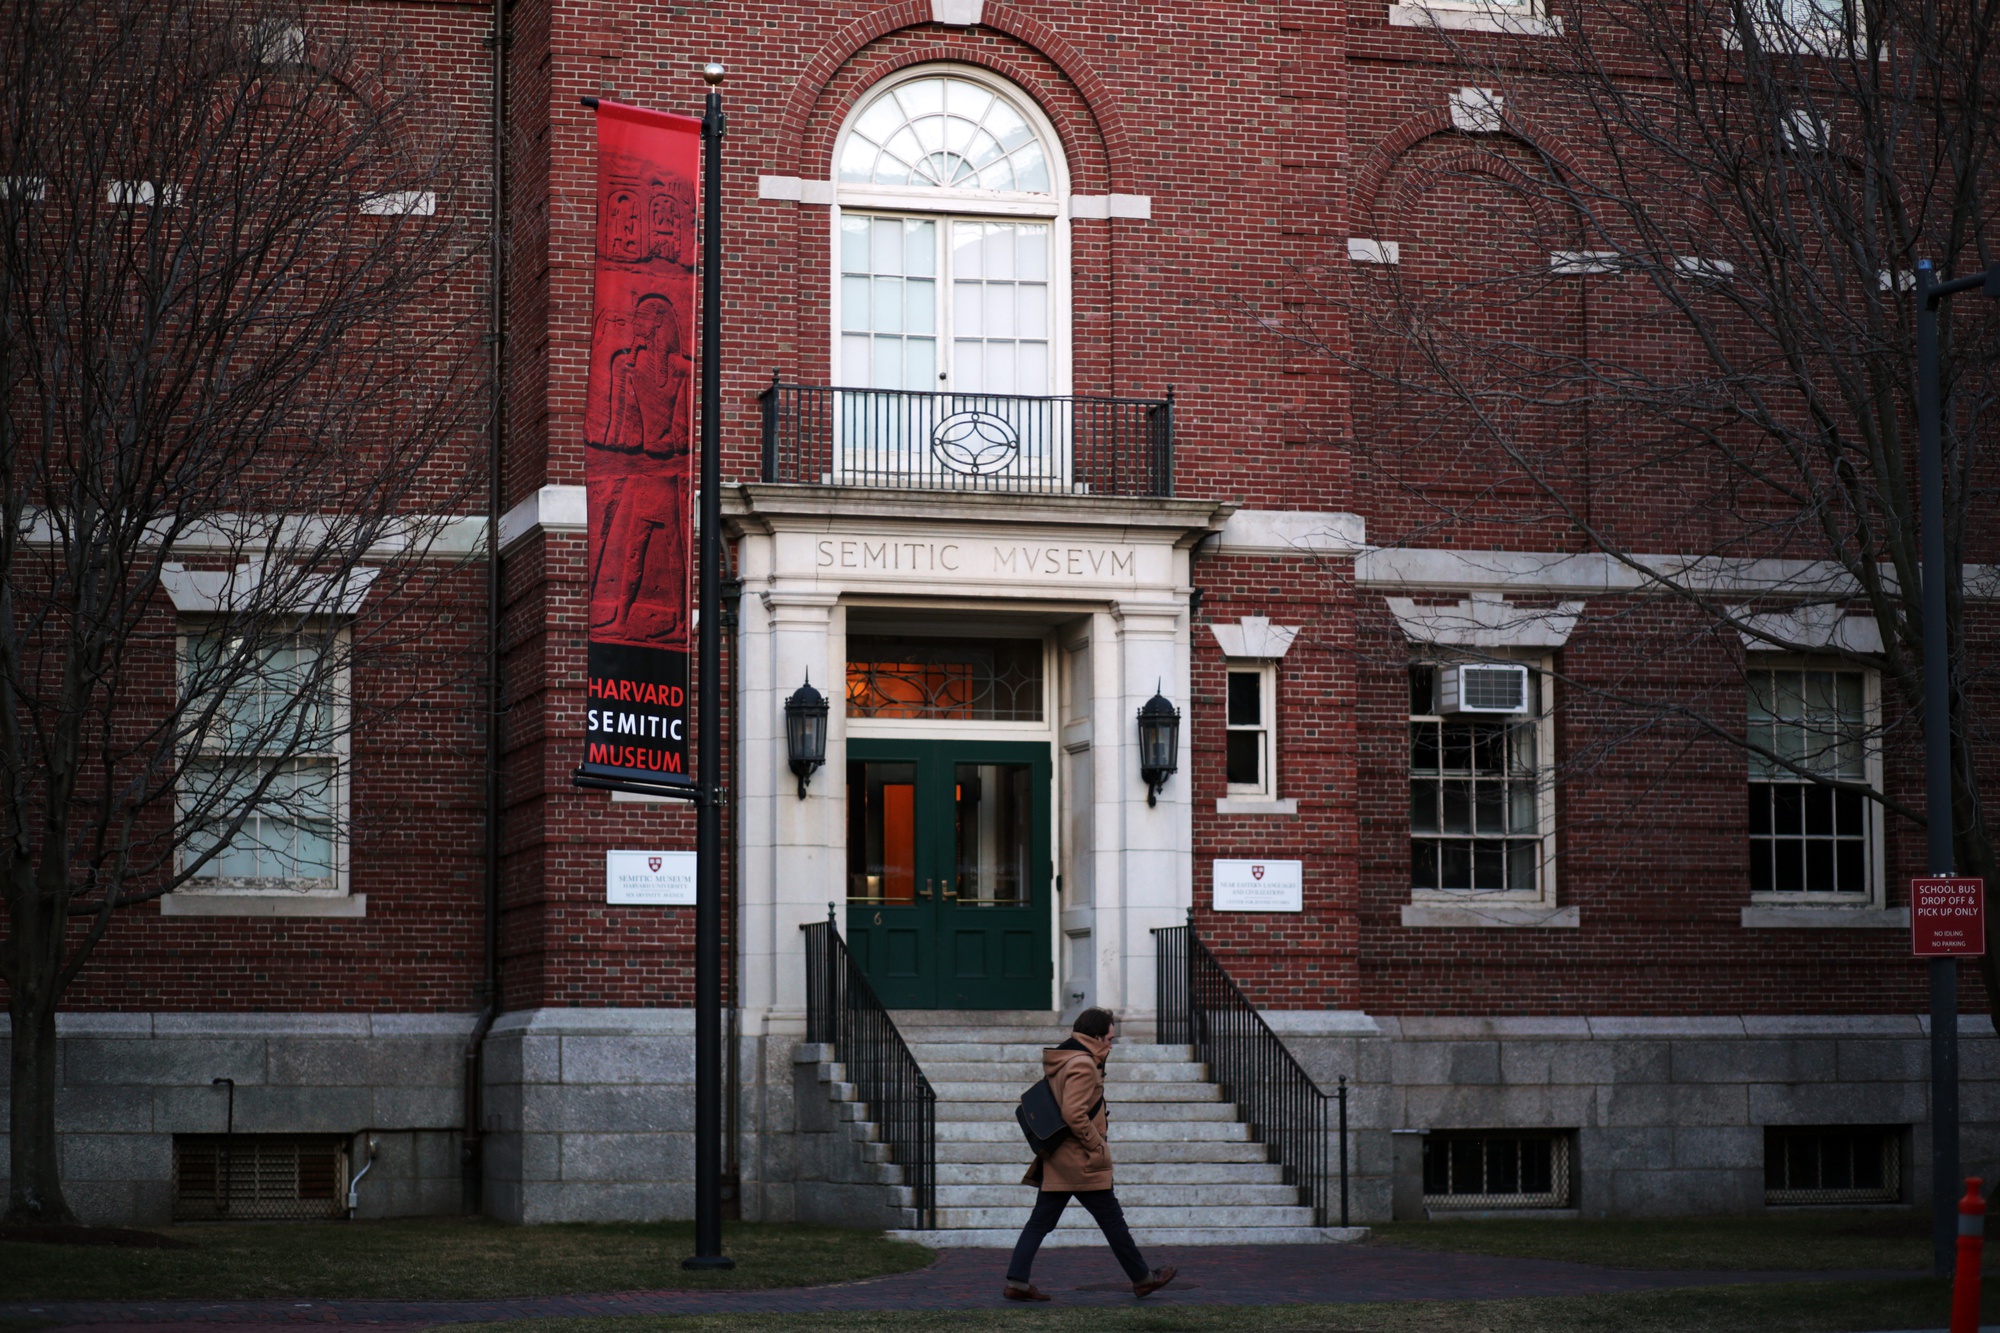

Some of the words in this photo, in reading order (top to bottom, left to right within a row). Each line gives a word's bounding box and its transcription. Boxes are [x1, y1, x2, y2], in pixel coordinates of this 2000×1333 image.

[818, 541, 959, 570] SEMITIC
[993, 546, 1134, 577] MVSEVM
[588, 677, 684, 707] HARVARD
[588, 709, 682, 740] SEMITIC
[589, 742, 681, 773] MUSEUM
[655, 875, 691, 883] MUSEUM
[1919, 885, 1956, 894] SCHOOL
[1958, 885, 1976, 894] BUS
[1921, 896, 1946, 905] DROP
[1948, 896, 1965, 905] OFF
[1968, 896, 1975, 905] &
[1918, 907, 1938, 916] PICK
[1940, 907, 1953, 916] UP
[1954, 907, 1978, 916] ONLY
[873, 912, 882, 926] 6
